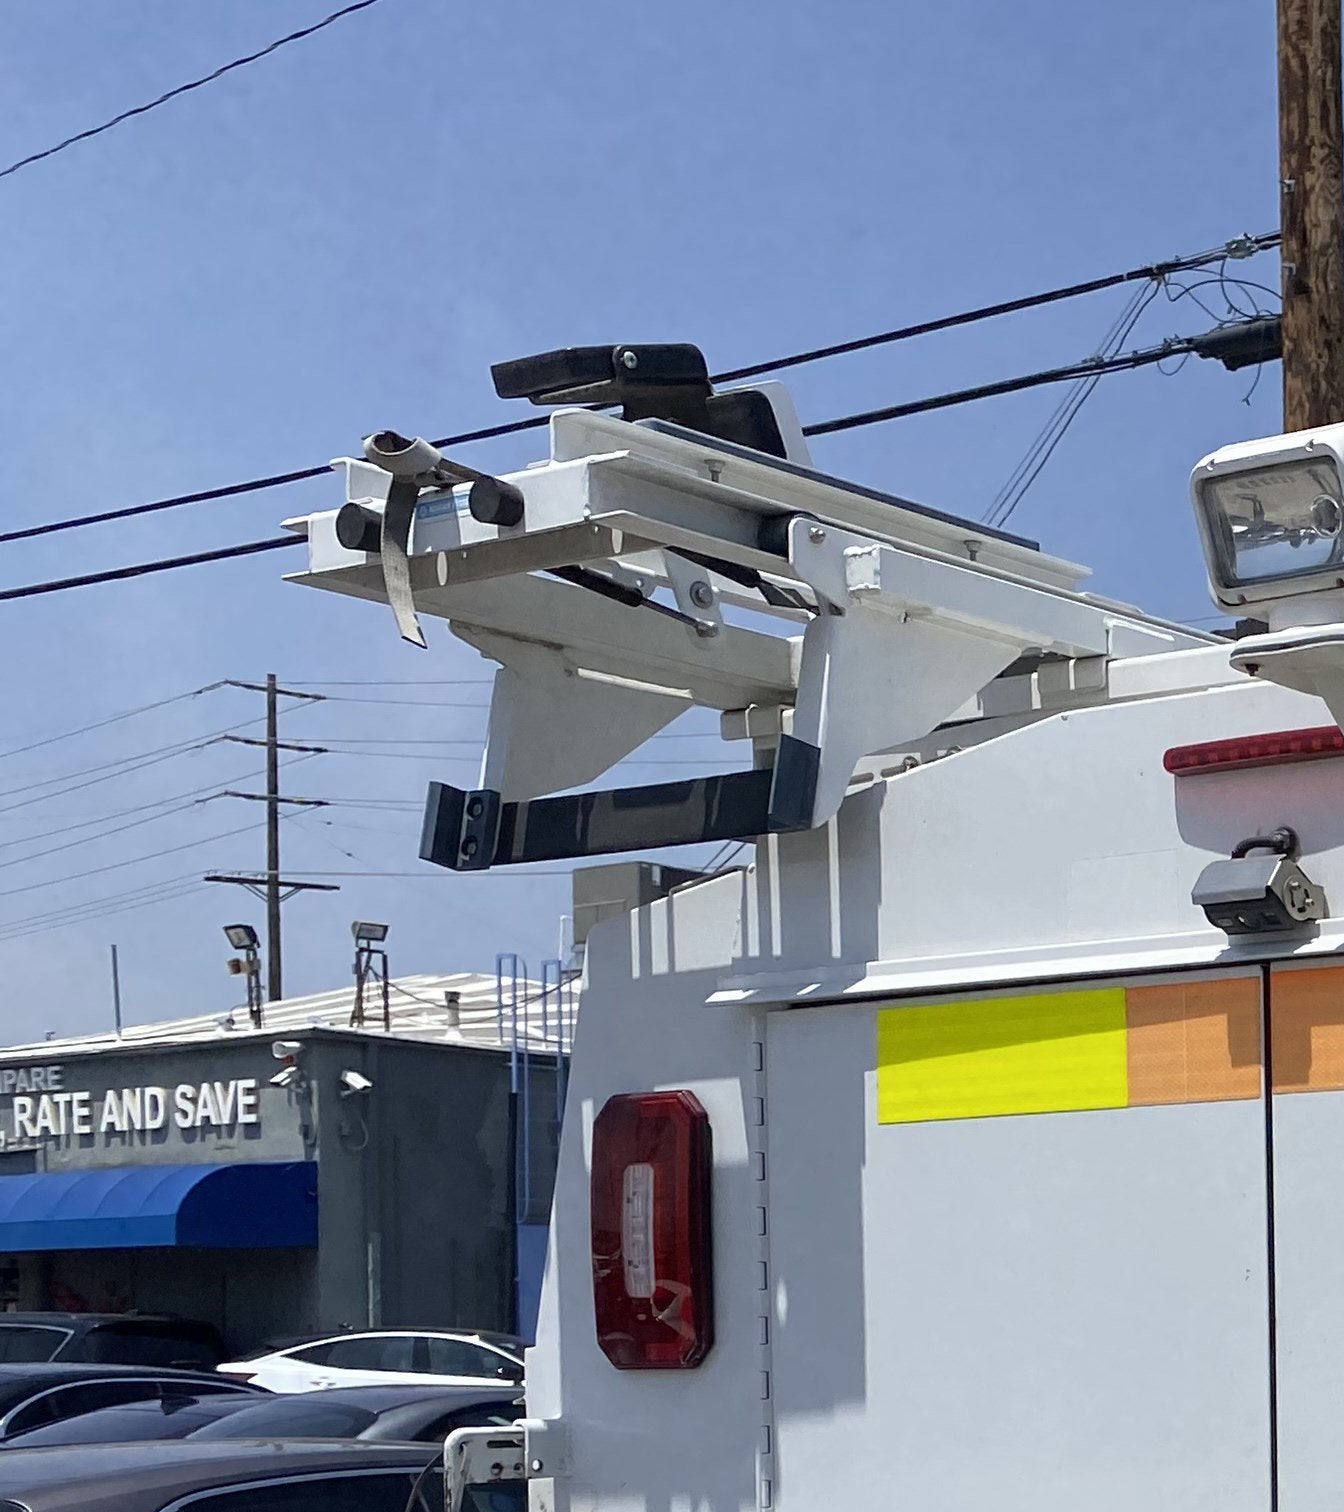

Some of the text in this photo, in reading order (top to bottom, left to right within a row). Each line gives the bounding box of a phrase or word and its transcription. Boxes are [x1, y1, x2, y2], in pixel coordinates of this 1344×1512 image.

[0, 1065, 64, 1093] PARE
[13, 1079, 258, 1137] RATE AND SAVE
